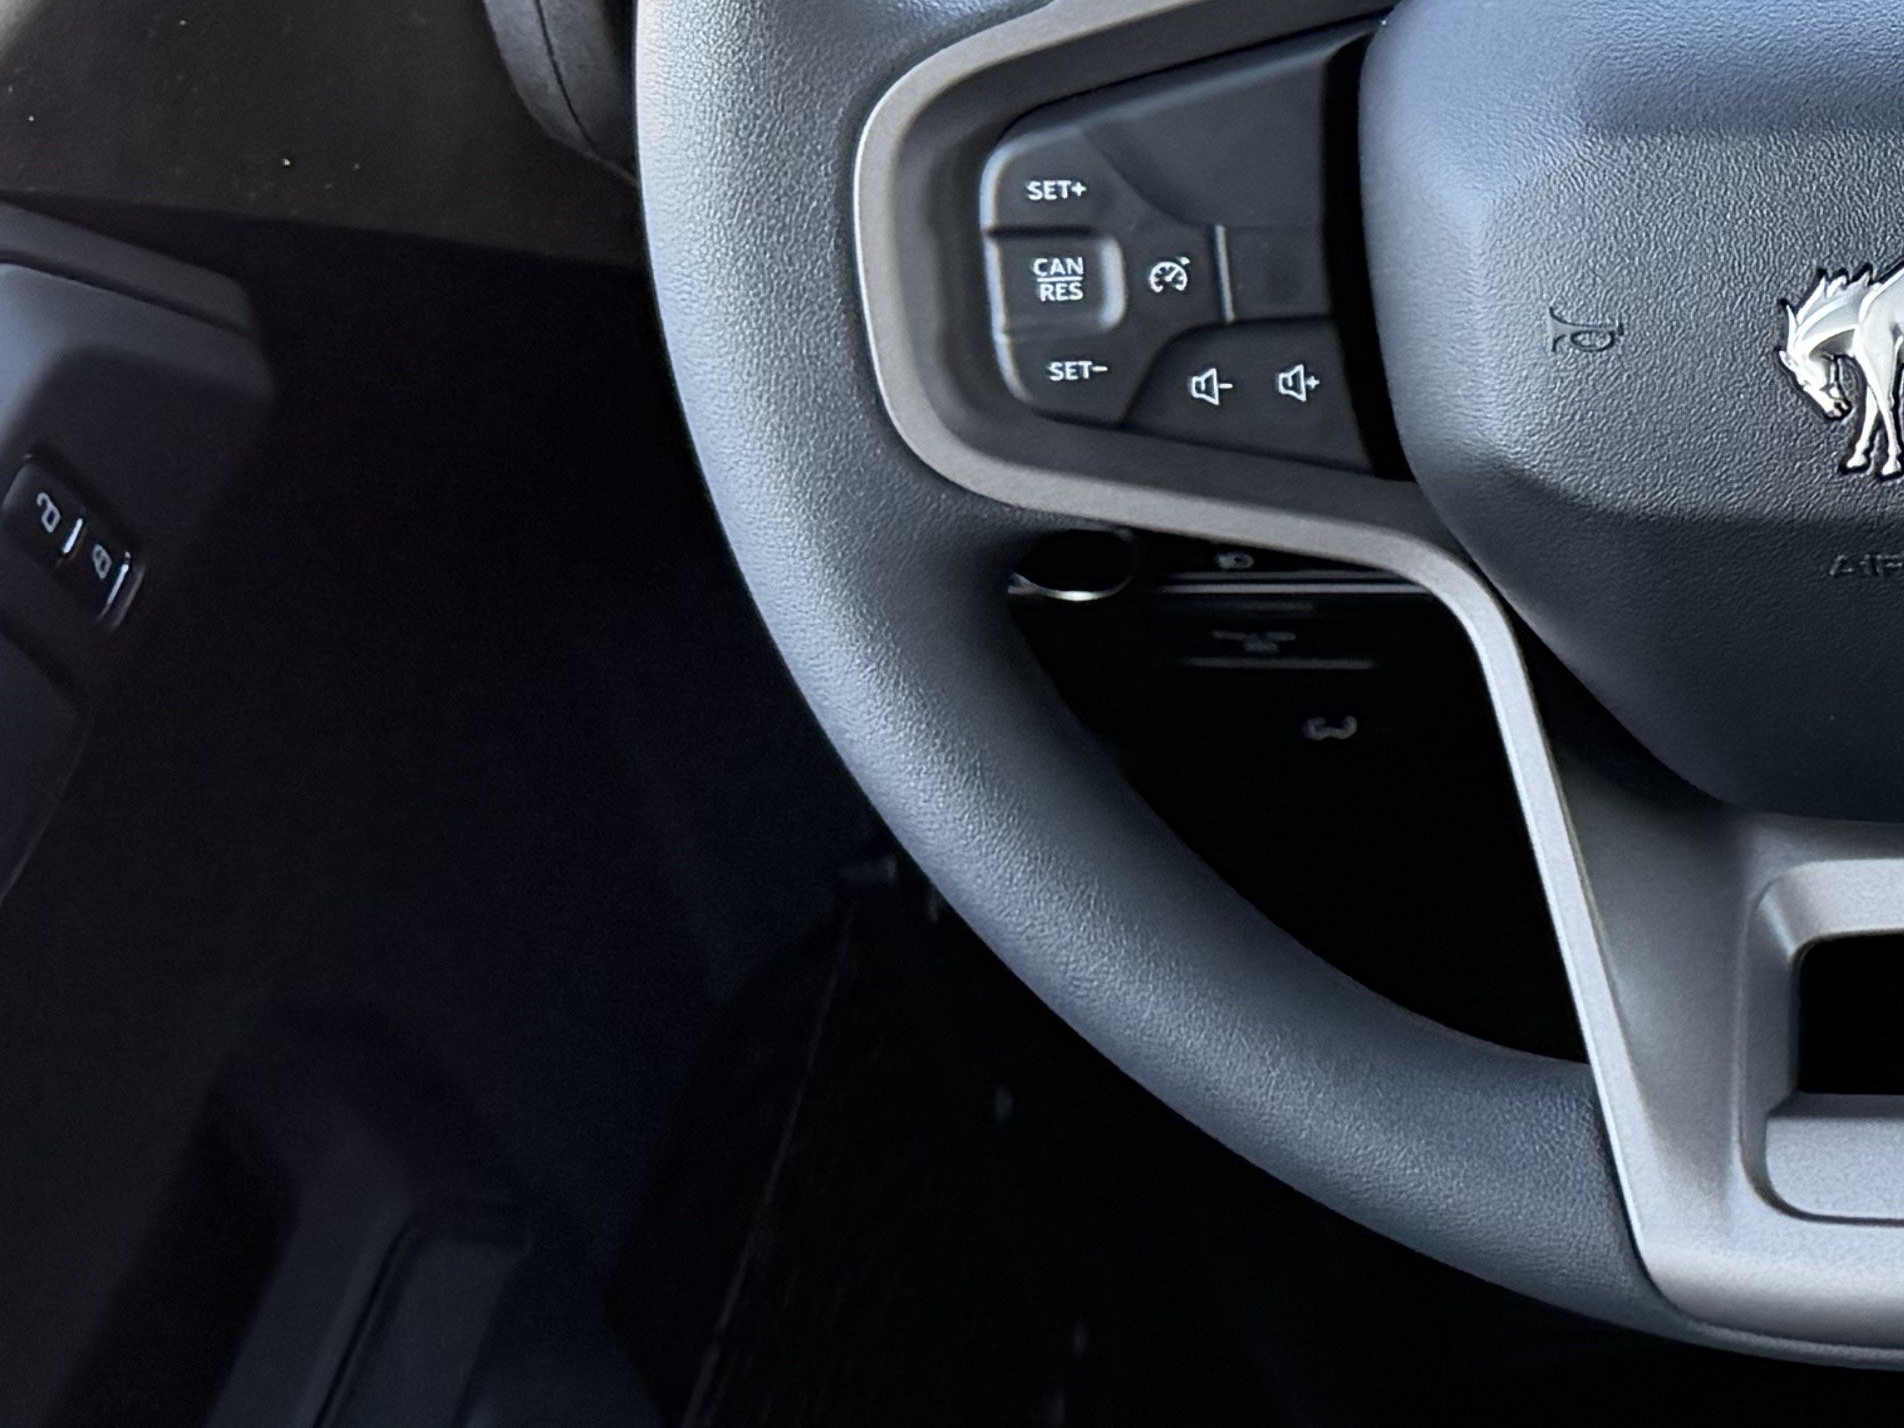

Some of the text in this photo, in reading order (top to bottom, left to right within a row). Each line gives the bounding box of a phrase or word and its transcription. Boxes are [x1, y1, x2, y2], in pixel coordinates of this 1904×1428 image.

[1026, 179, 1088, 202] SET+
[1032, 256, 1085, 278] CAN
[1038, 282, 1084, 303] RES
